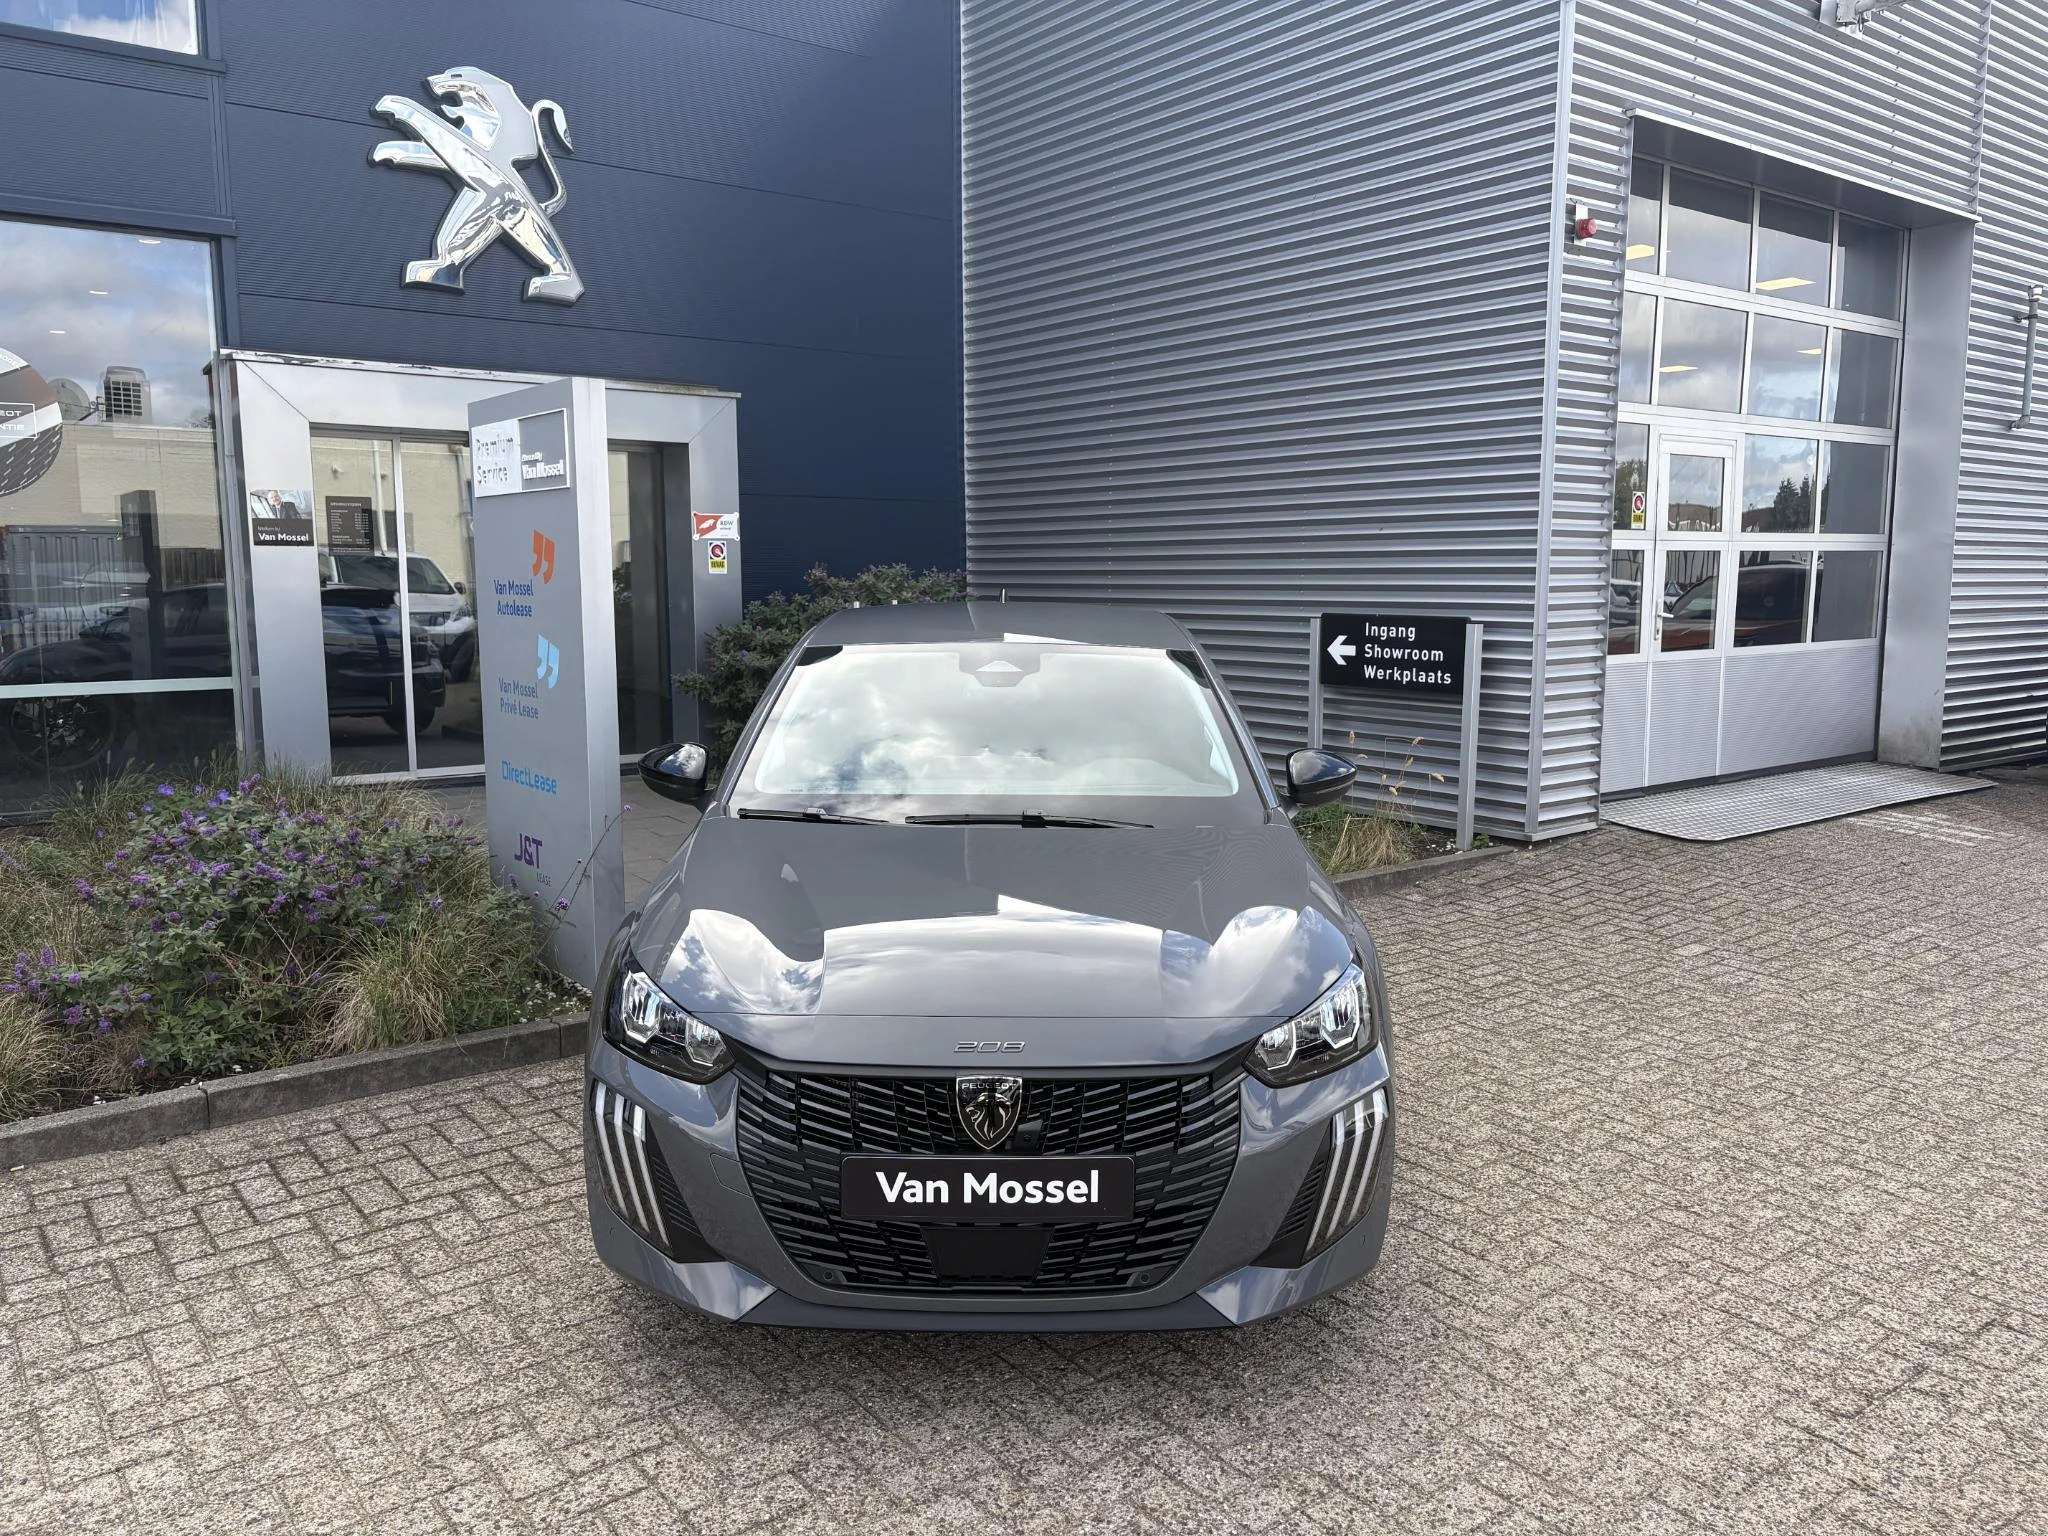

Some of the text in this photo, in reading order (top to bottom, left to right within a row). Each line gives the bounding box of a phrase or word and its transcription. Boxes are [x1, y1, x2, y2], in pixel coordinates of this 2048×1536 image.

[476, 433, 513, 457] Premium
[478, 462, 507, 485] Service
[536, 459, 564, 478] Mossel
[258, 532, 309, 542] Van Mossel
[494, 578, 534, 596] Van Mossel
[497, 600, 532, 618] Autolease
[1365, 622, 1416, 642] Ingang
[1364, 643, 1444, 662] Showroom
[1364, 665, 1452, 685] Werkplaats
[498, 677, 539, 699] Van Mossel
[500, 697, 539, 719] Privé Lease
[501, 760, 557, 794] DirectLease
[514, 832, 543, 869] J&T
[953, 1041, 1025, 1053] 208
[961, 1081, 1018, 1090] PEUGEOT
[875, 1169, 1099, 1204] Van Mossel
